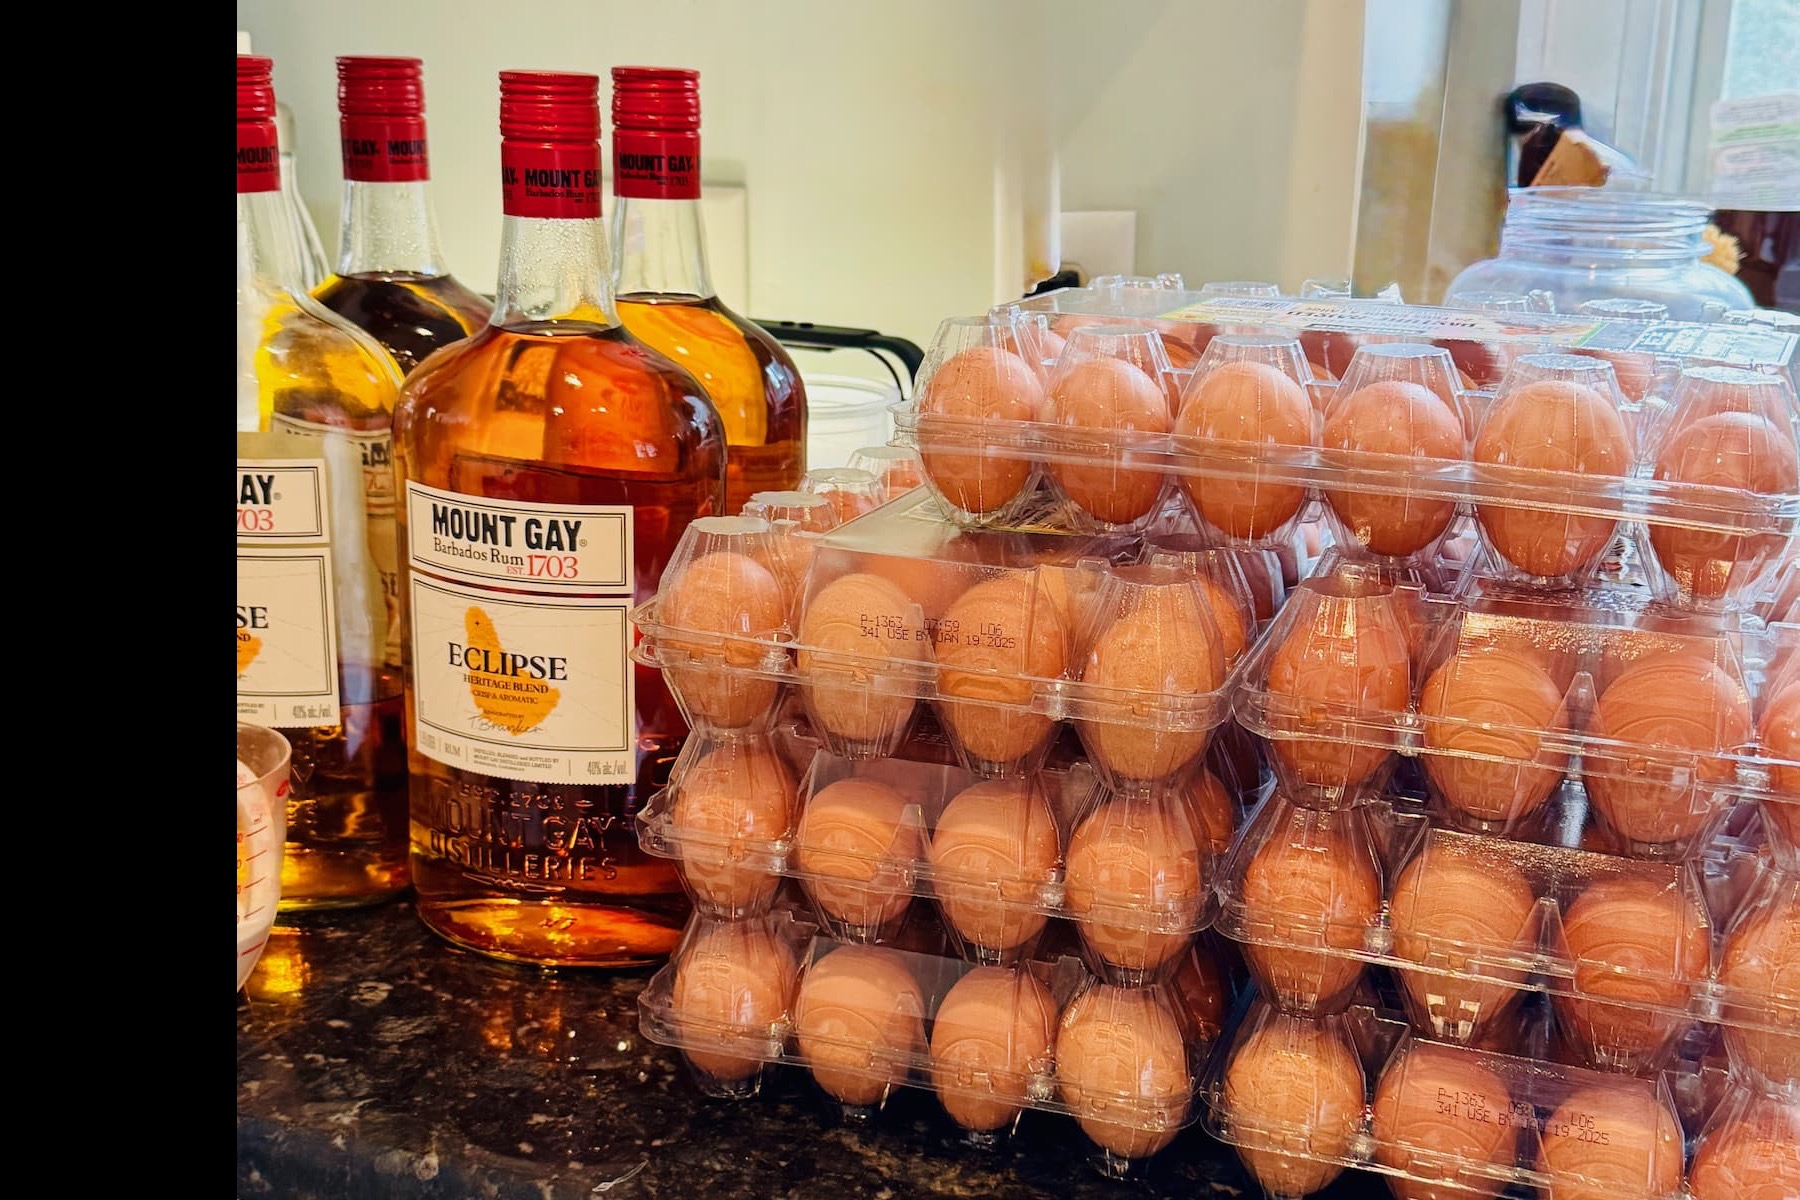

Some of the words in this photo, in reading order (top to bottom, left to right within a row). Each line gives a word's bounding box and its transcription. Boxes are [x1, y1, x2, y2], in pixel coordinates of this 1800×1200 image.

[387, 140, 427, 155] MOUN
[619, 153, 665, 171] MOUNT
[668, 155, 692, 172] GAY
[525, 168, 581, 188] MOUNT
[237, 474, 275, 505] AY
[432, 503, 517, 547] MOUNT
[525, 518, 581, 552] GAY
[433, 538, 487, 562] Barbados
[490, 549, 525, 566] Rum
[527, 554, 579, 579] 1703
[860, 614, 903, 629] P-1363
[860, 626, 879, 638] 341
[887, 629, 909, 641] USE
[916, 630, 930, 642] BY
[936, 632, 959, 644] JAN
[966, 635, 979, 646] 19
[987, 636, 1016, 649] 2025
[447, 641, 568, 681] ECLIPSE
[463, 673, 512, 690] HERITAGE
[513, 682, 549, 694] BLEND
[543, 815, 616, 851] GAY
[1437, 1087, 1485, 1109] P-1363
[1435, 1101, 1459, 1117] 341
[1467, 1108, 1490, 1124] USE
[1554, 1124, 1570, 1138] 19
[1577, 1127, 1610, 1145] 2025
